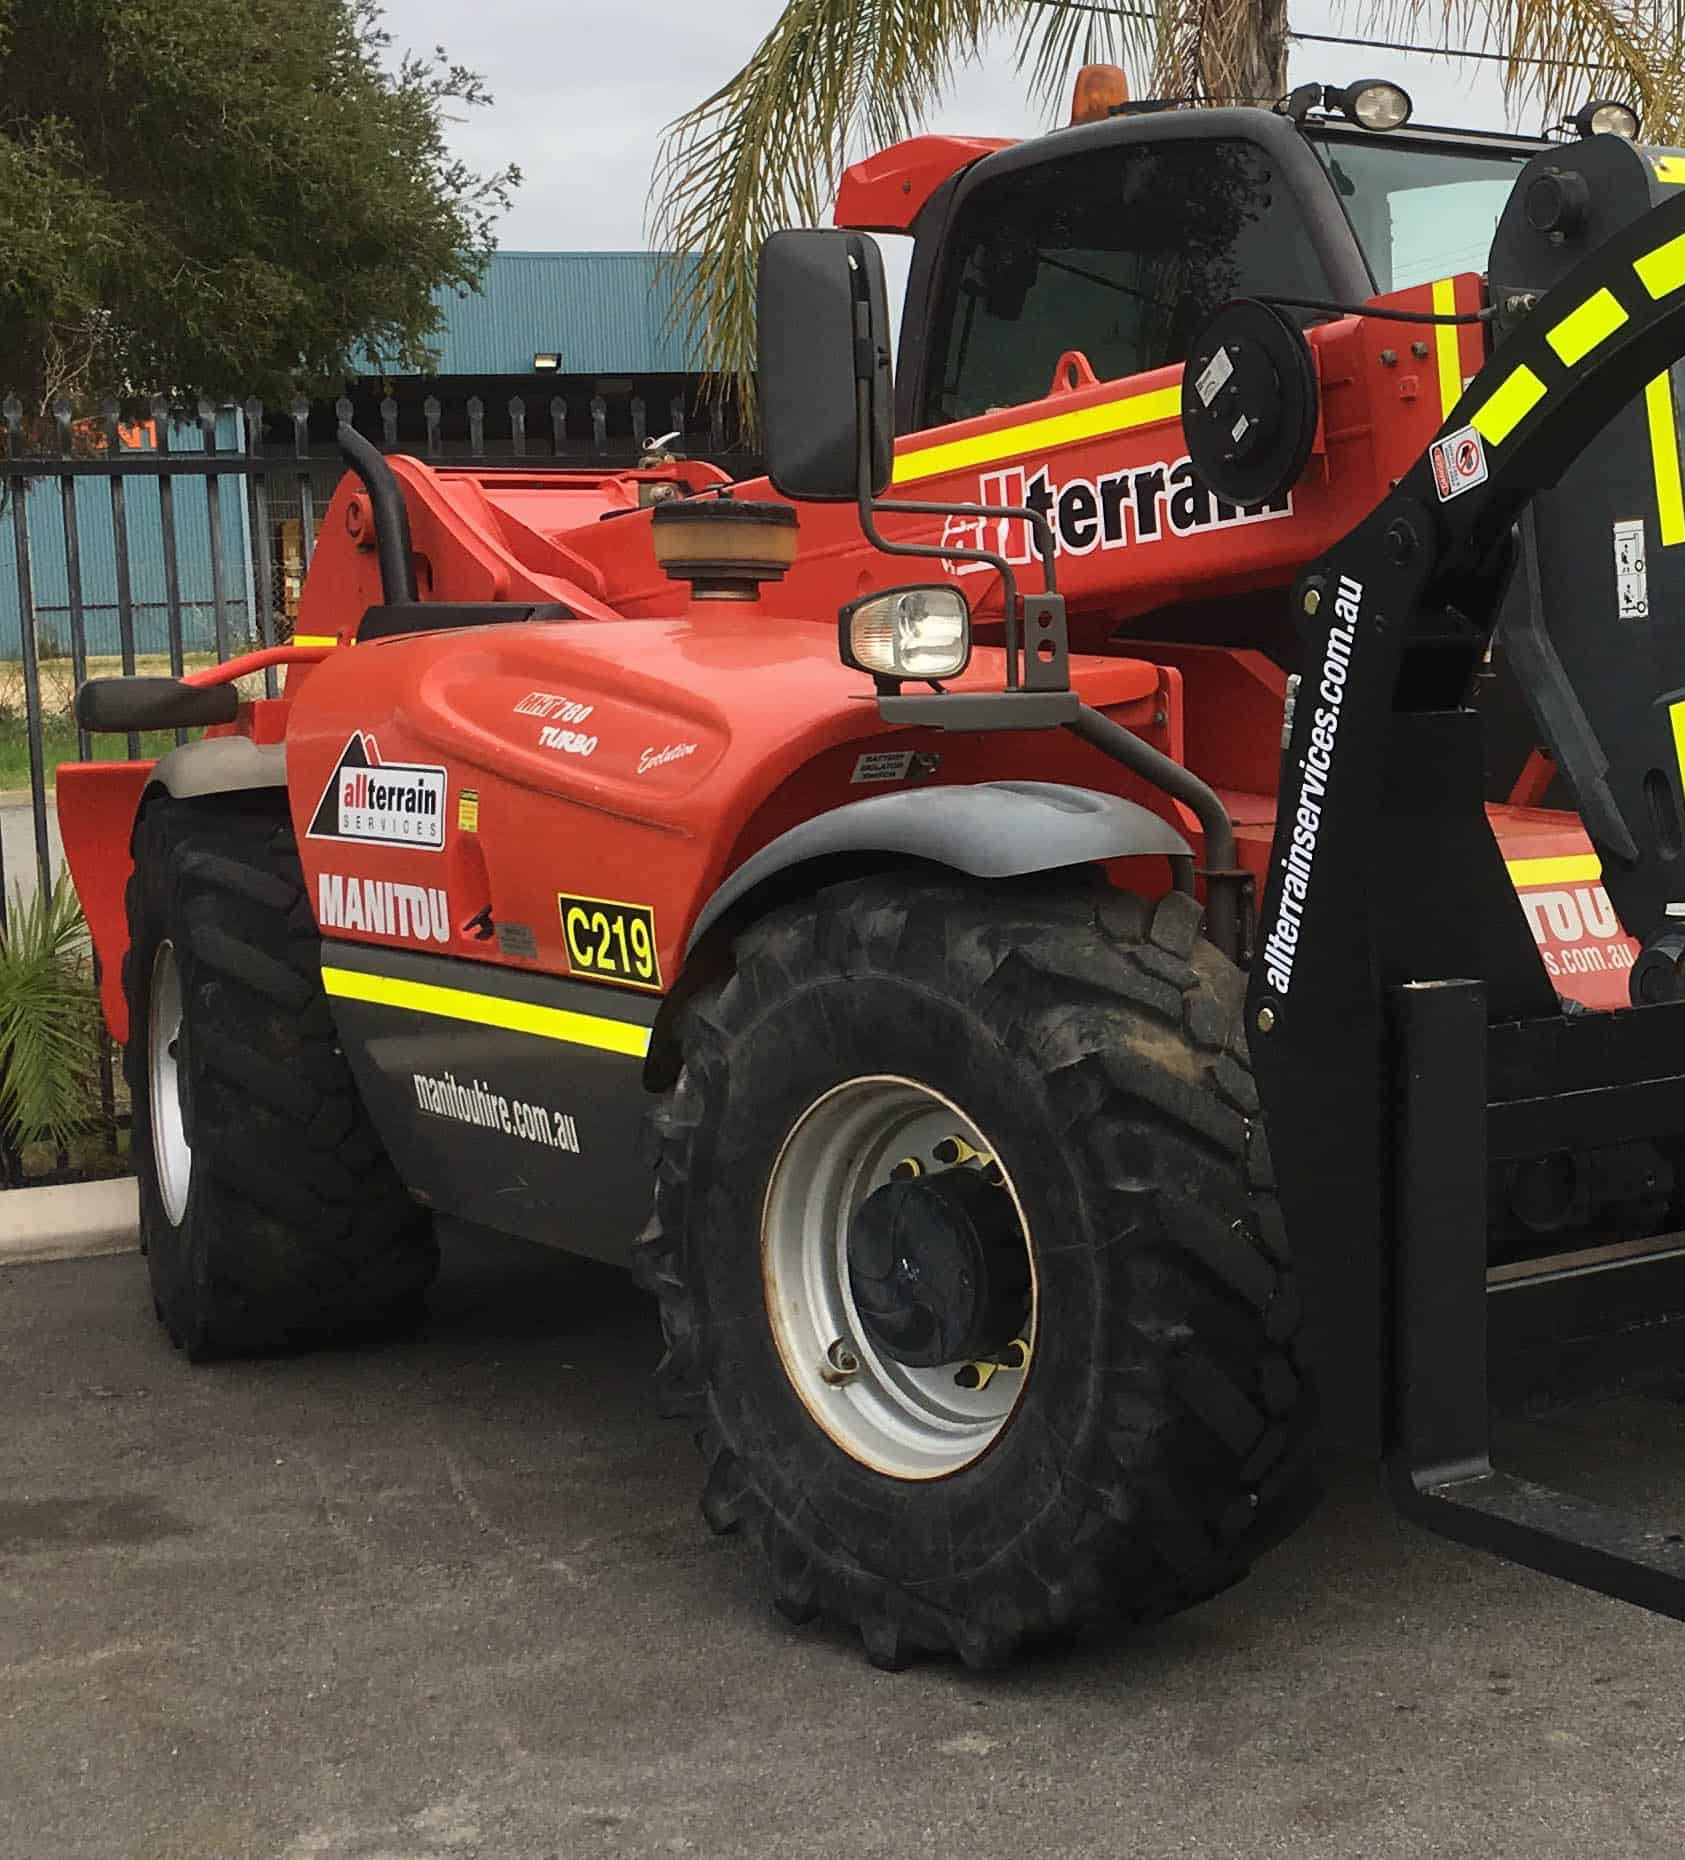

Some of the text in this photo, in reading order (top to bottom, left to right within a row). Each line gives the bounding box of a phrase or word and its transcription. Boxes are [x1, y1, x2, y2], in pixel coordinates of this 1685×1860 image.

[539, 725, 598, 756] TURBO
[344, 773, 436, 815] allterrain
[1266, 575, 1364, 995] allterrainservices.com.au
[343, 814, 436, 837] SERVICES
[318, 873, 450, 944] MANITOU
[567, 907, 653, 978] C219
[413, 1071, 580, 1154] manitouhire.com.au
